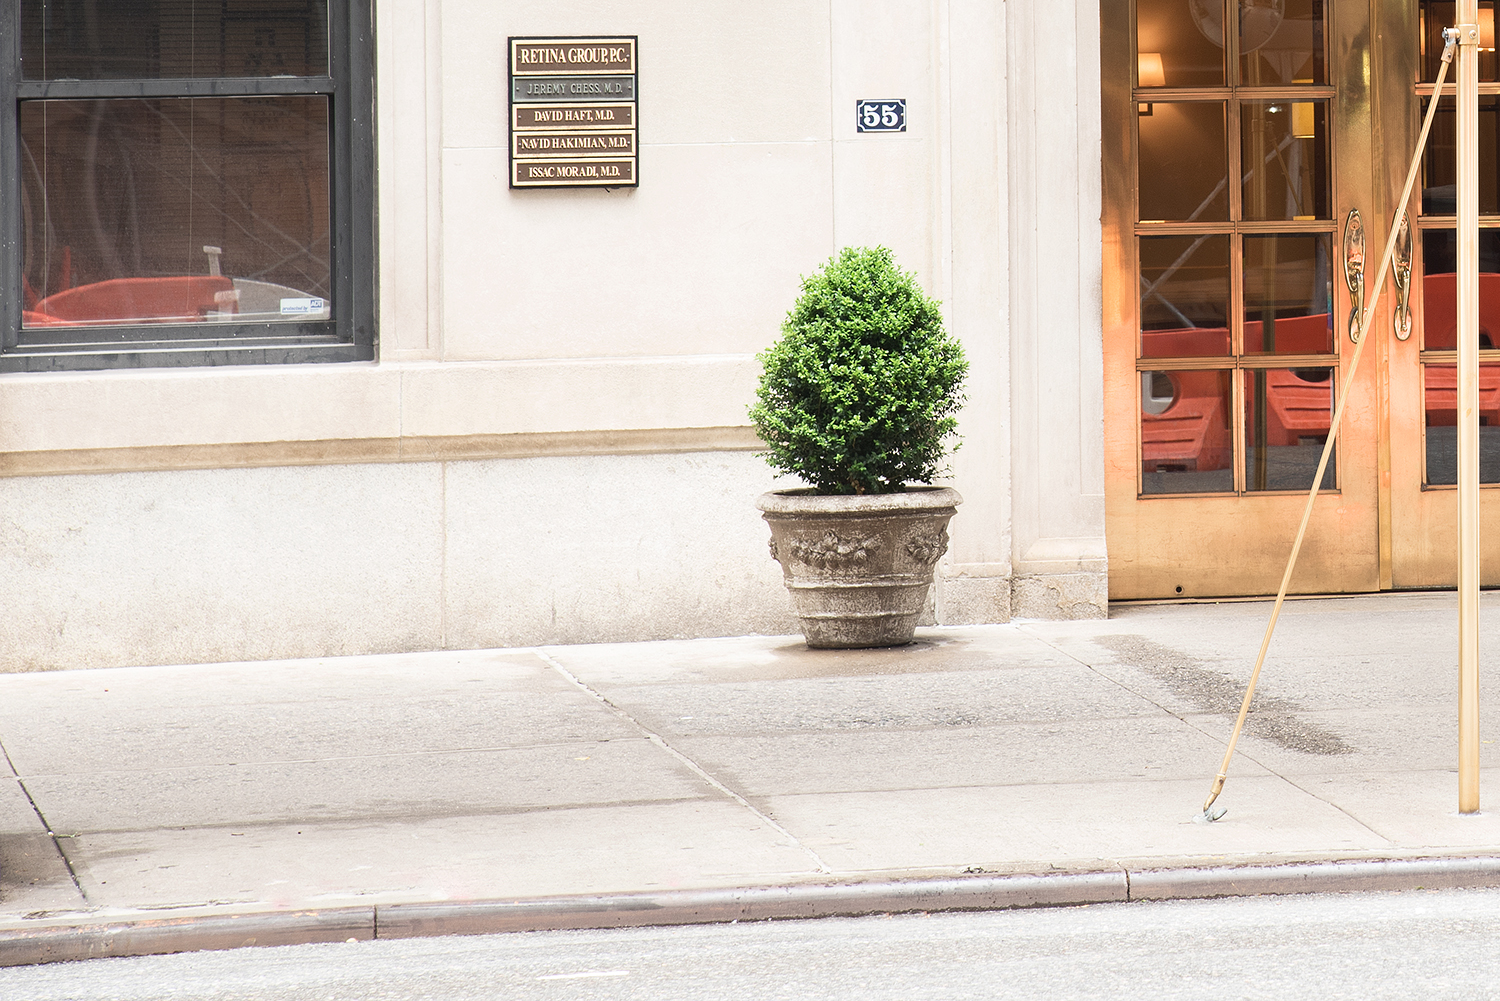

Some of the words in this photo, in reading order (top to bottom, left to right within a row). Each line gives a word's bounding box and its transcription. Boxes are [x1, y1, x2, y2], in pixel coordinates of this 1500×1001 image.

[520, 48, 567, 64] RETINA
[527, 83, 567, 95] JEREMY
[534, 110, 564, 122] DAVID
[564, 110, 594, 123] HAFT,
[595, 109, 616, 121] M.D.
[863, 104, 899, 127] 55
[521, 138, 551, 149] NAVID
[551, 137, 608, 150] HAKIMIAN,
[608, 137, 628, 148] M.D.
[528, 166, 556, 178] ISSAC
[556, 165, 600, 179] MORADI,
[600, 165, 621, 177] M.D.
